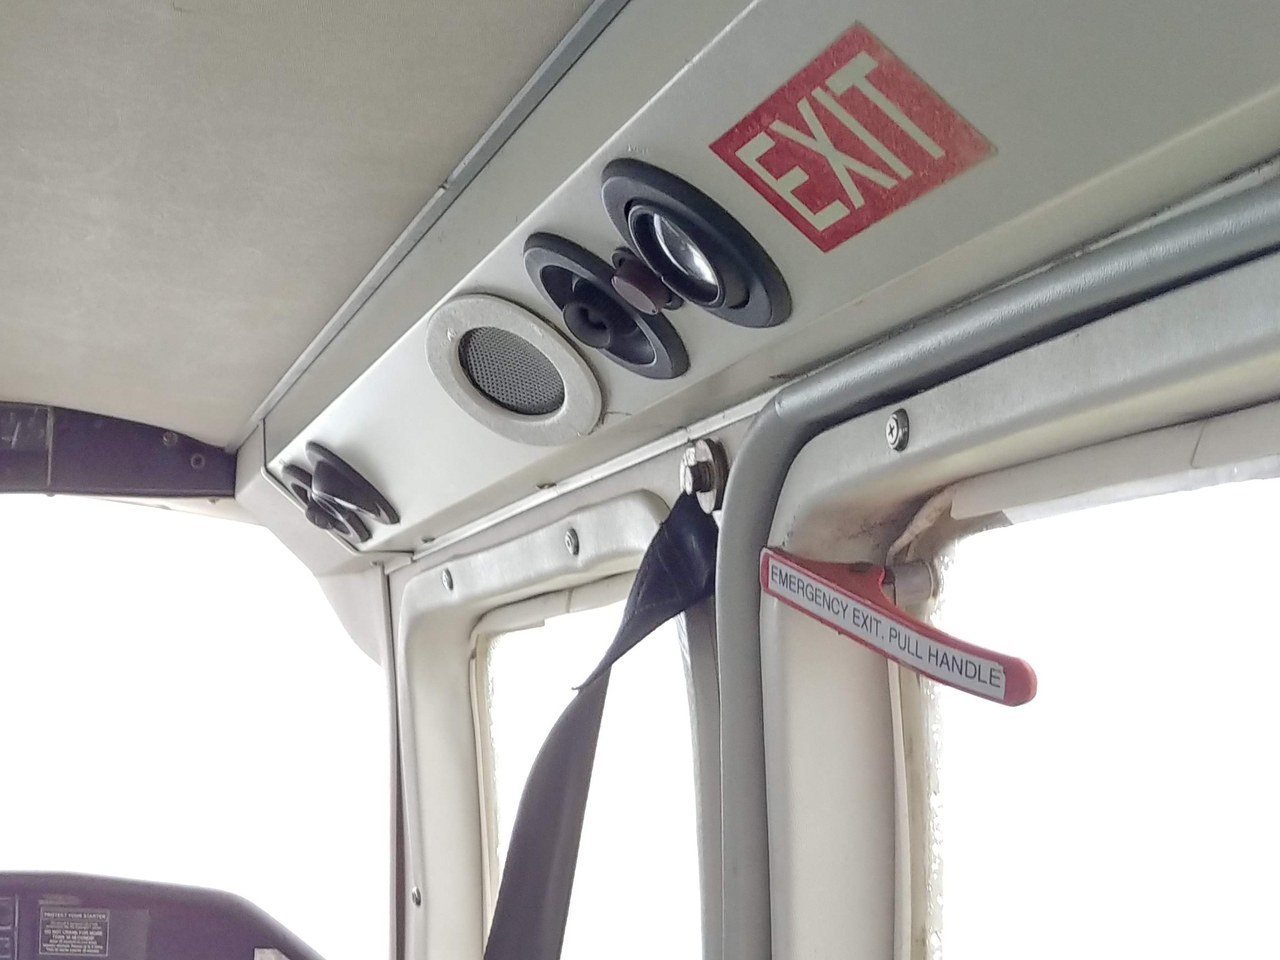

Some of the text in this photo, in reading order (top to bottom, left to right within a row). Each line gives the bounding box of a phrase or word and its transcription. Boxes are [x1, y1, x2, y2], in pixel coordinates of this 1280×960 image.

[734, 50, 947, 233] EXIT
[770, 563, 849, 620] EMERGENCY
[888, 626, 923, 661] PULL
[927, 644, 1003, 689] HANDLE
